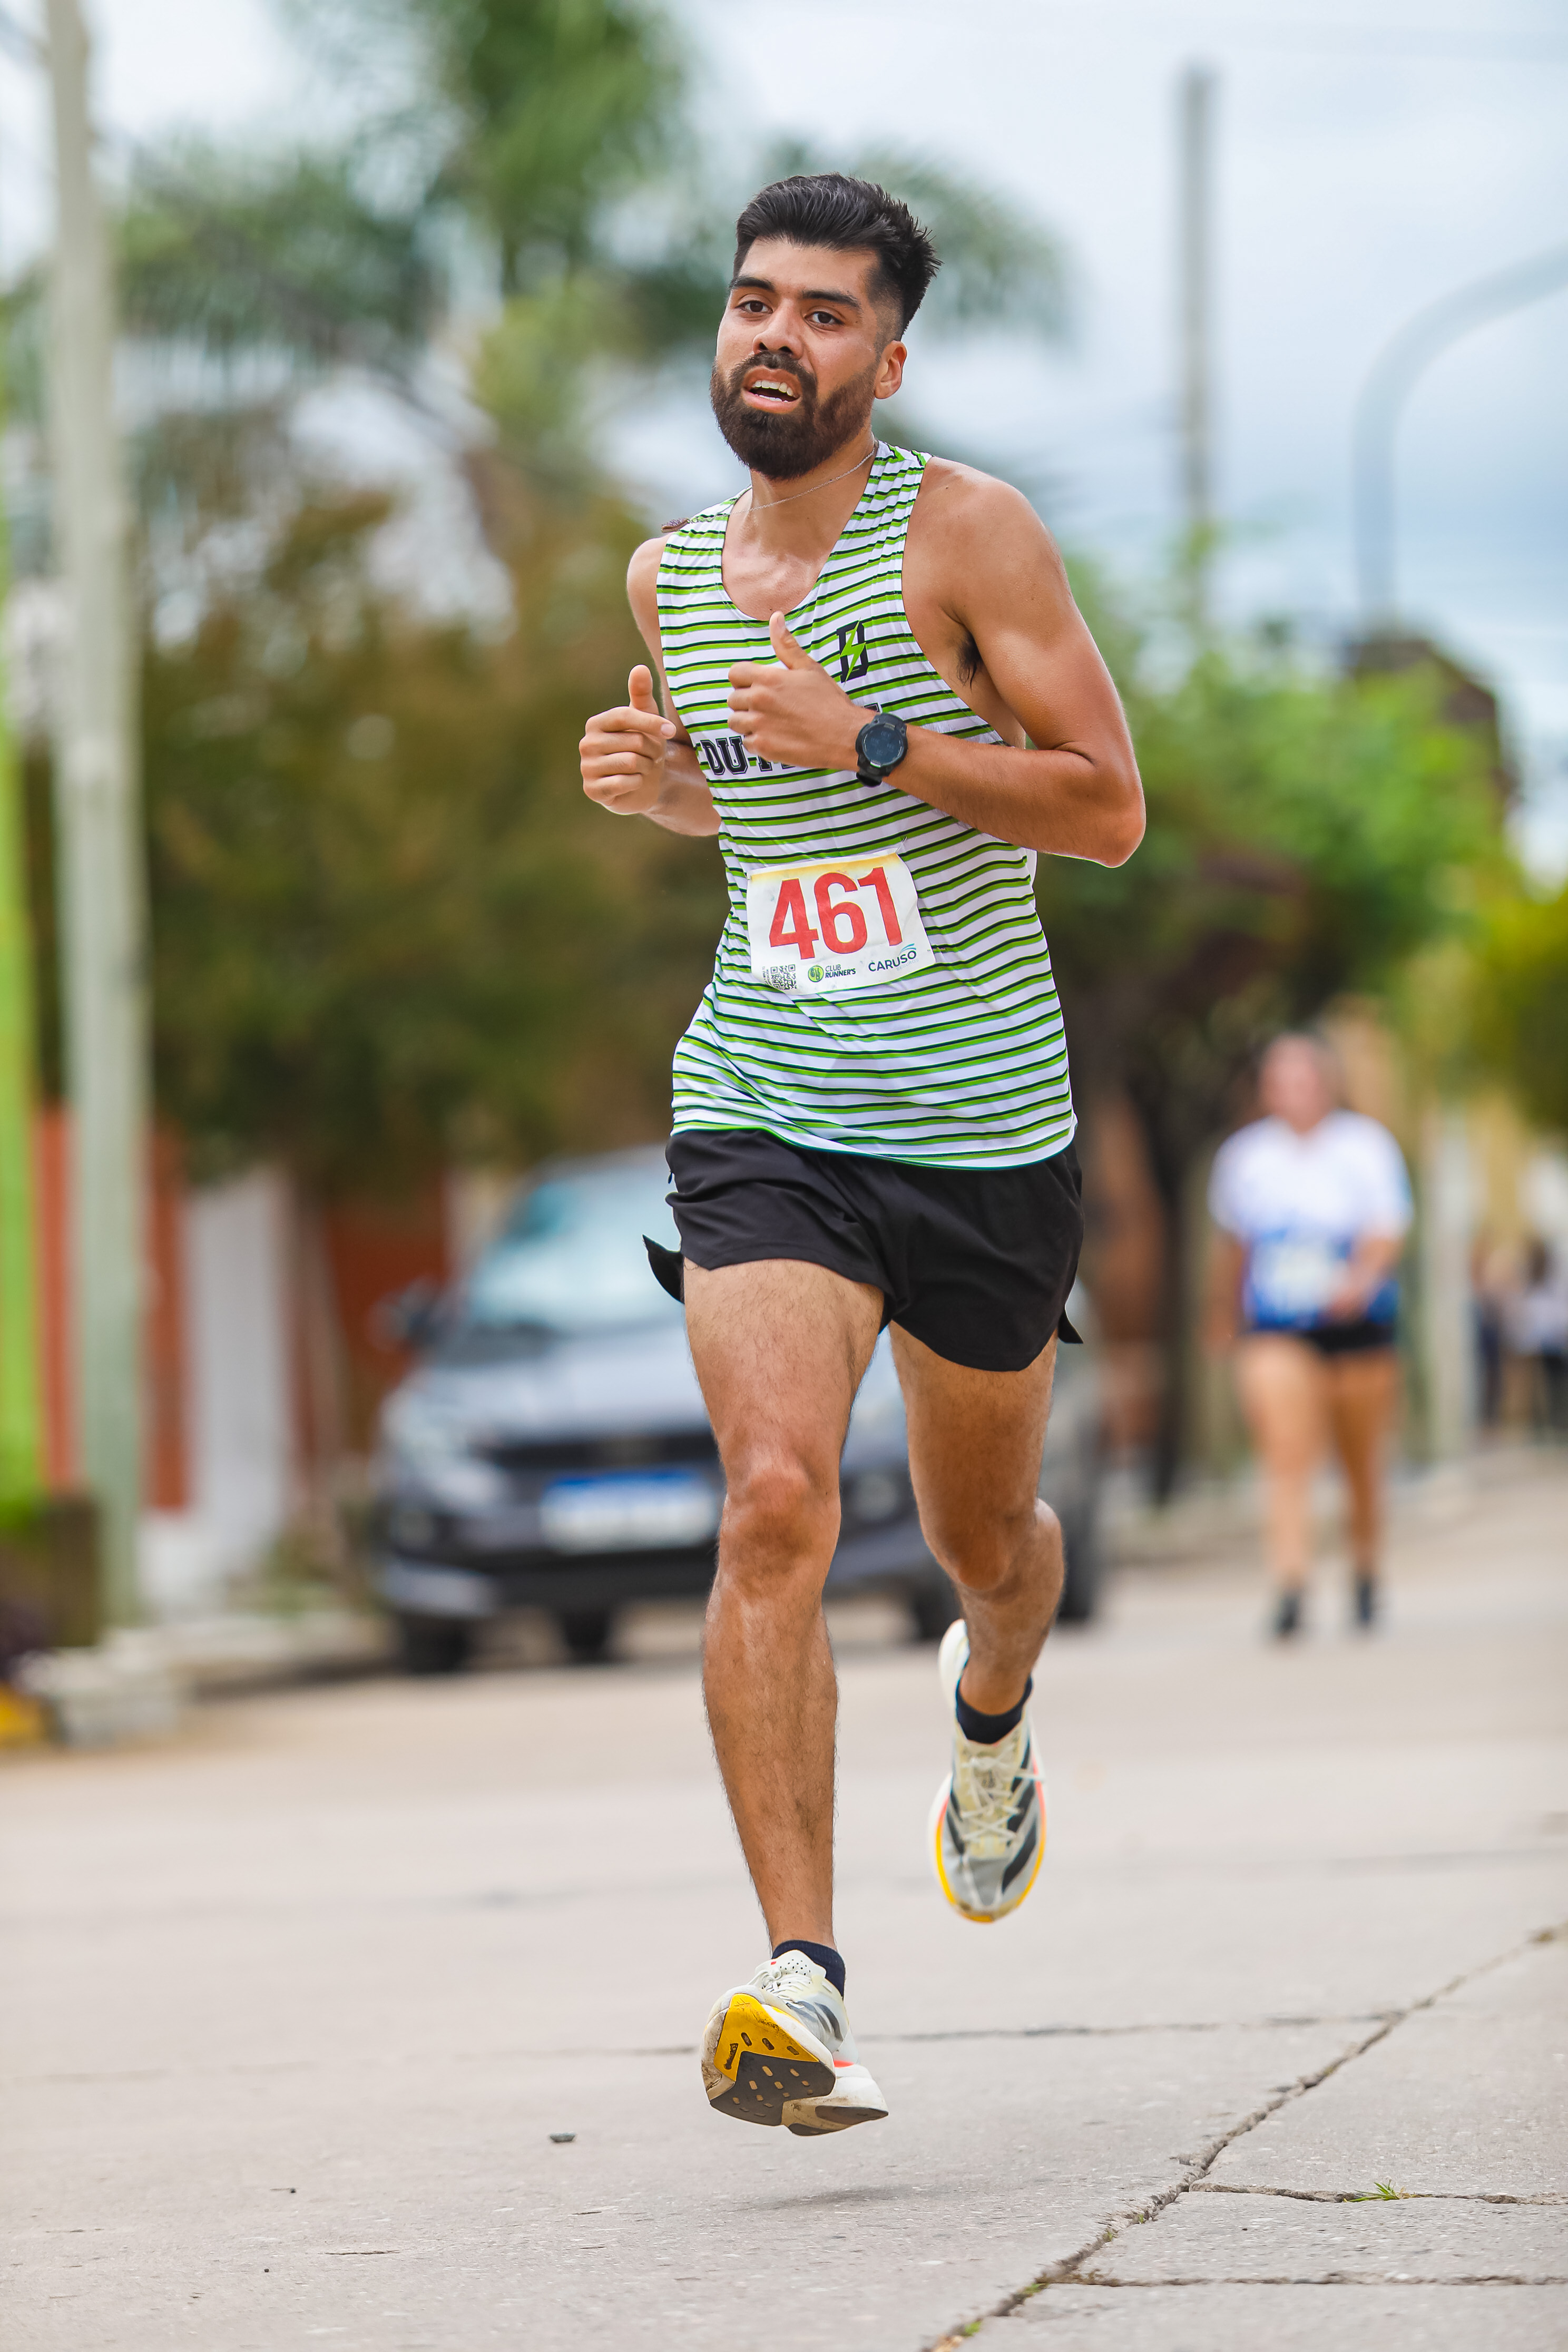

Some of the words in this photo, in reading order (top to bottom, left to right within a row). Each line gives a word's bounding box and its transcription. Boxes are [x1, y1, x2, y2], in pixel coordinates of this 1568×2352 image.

[769, 866, 903, 959] 461
[868, 950, 917, 972] CARUSO
[825, 968, 856, 978] RUNNER'S
